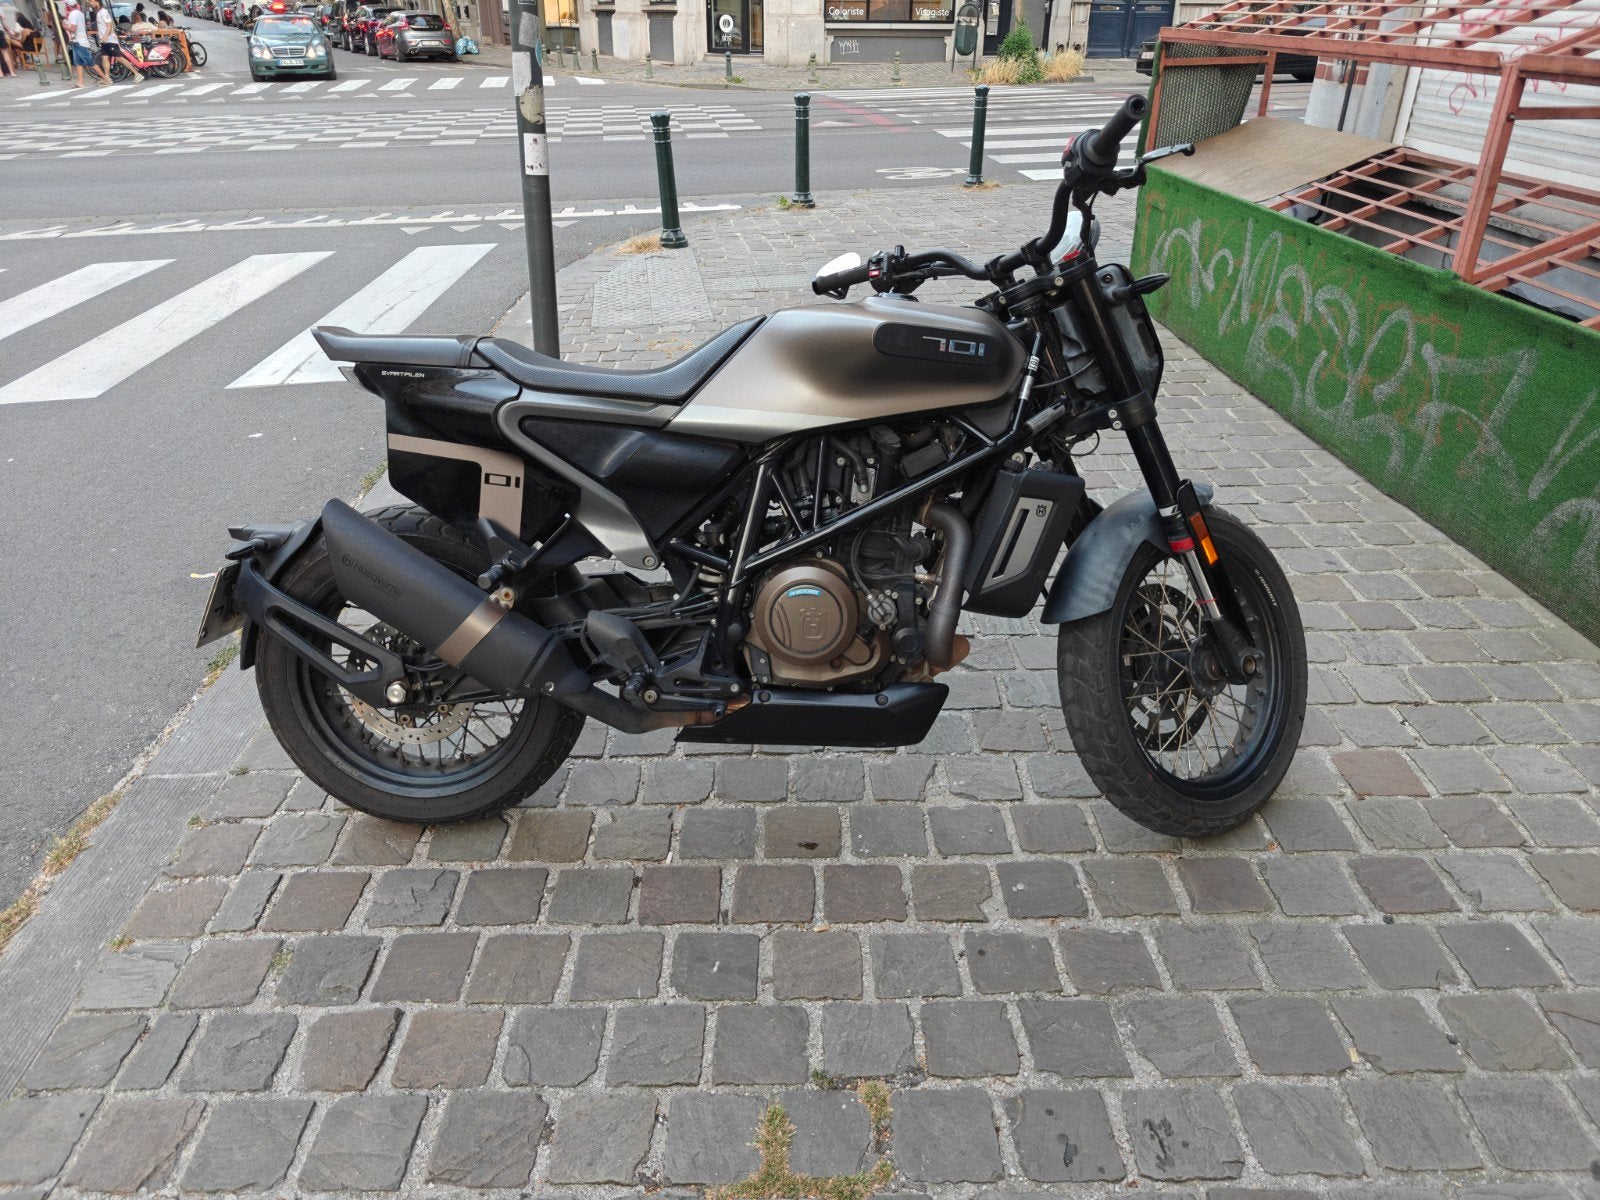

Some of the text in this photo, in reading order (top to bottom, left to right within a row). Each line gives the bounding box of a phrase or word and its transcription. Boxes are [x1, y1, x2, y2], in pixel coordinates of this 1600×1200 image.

[828, 6, 865, 16] Coloriste
[915, 7, 950, 18] Visagiste
[922, 336, 985, 356] 701
[353, 561, 402, 597] Husqvarna
